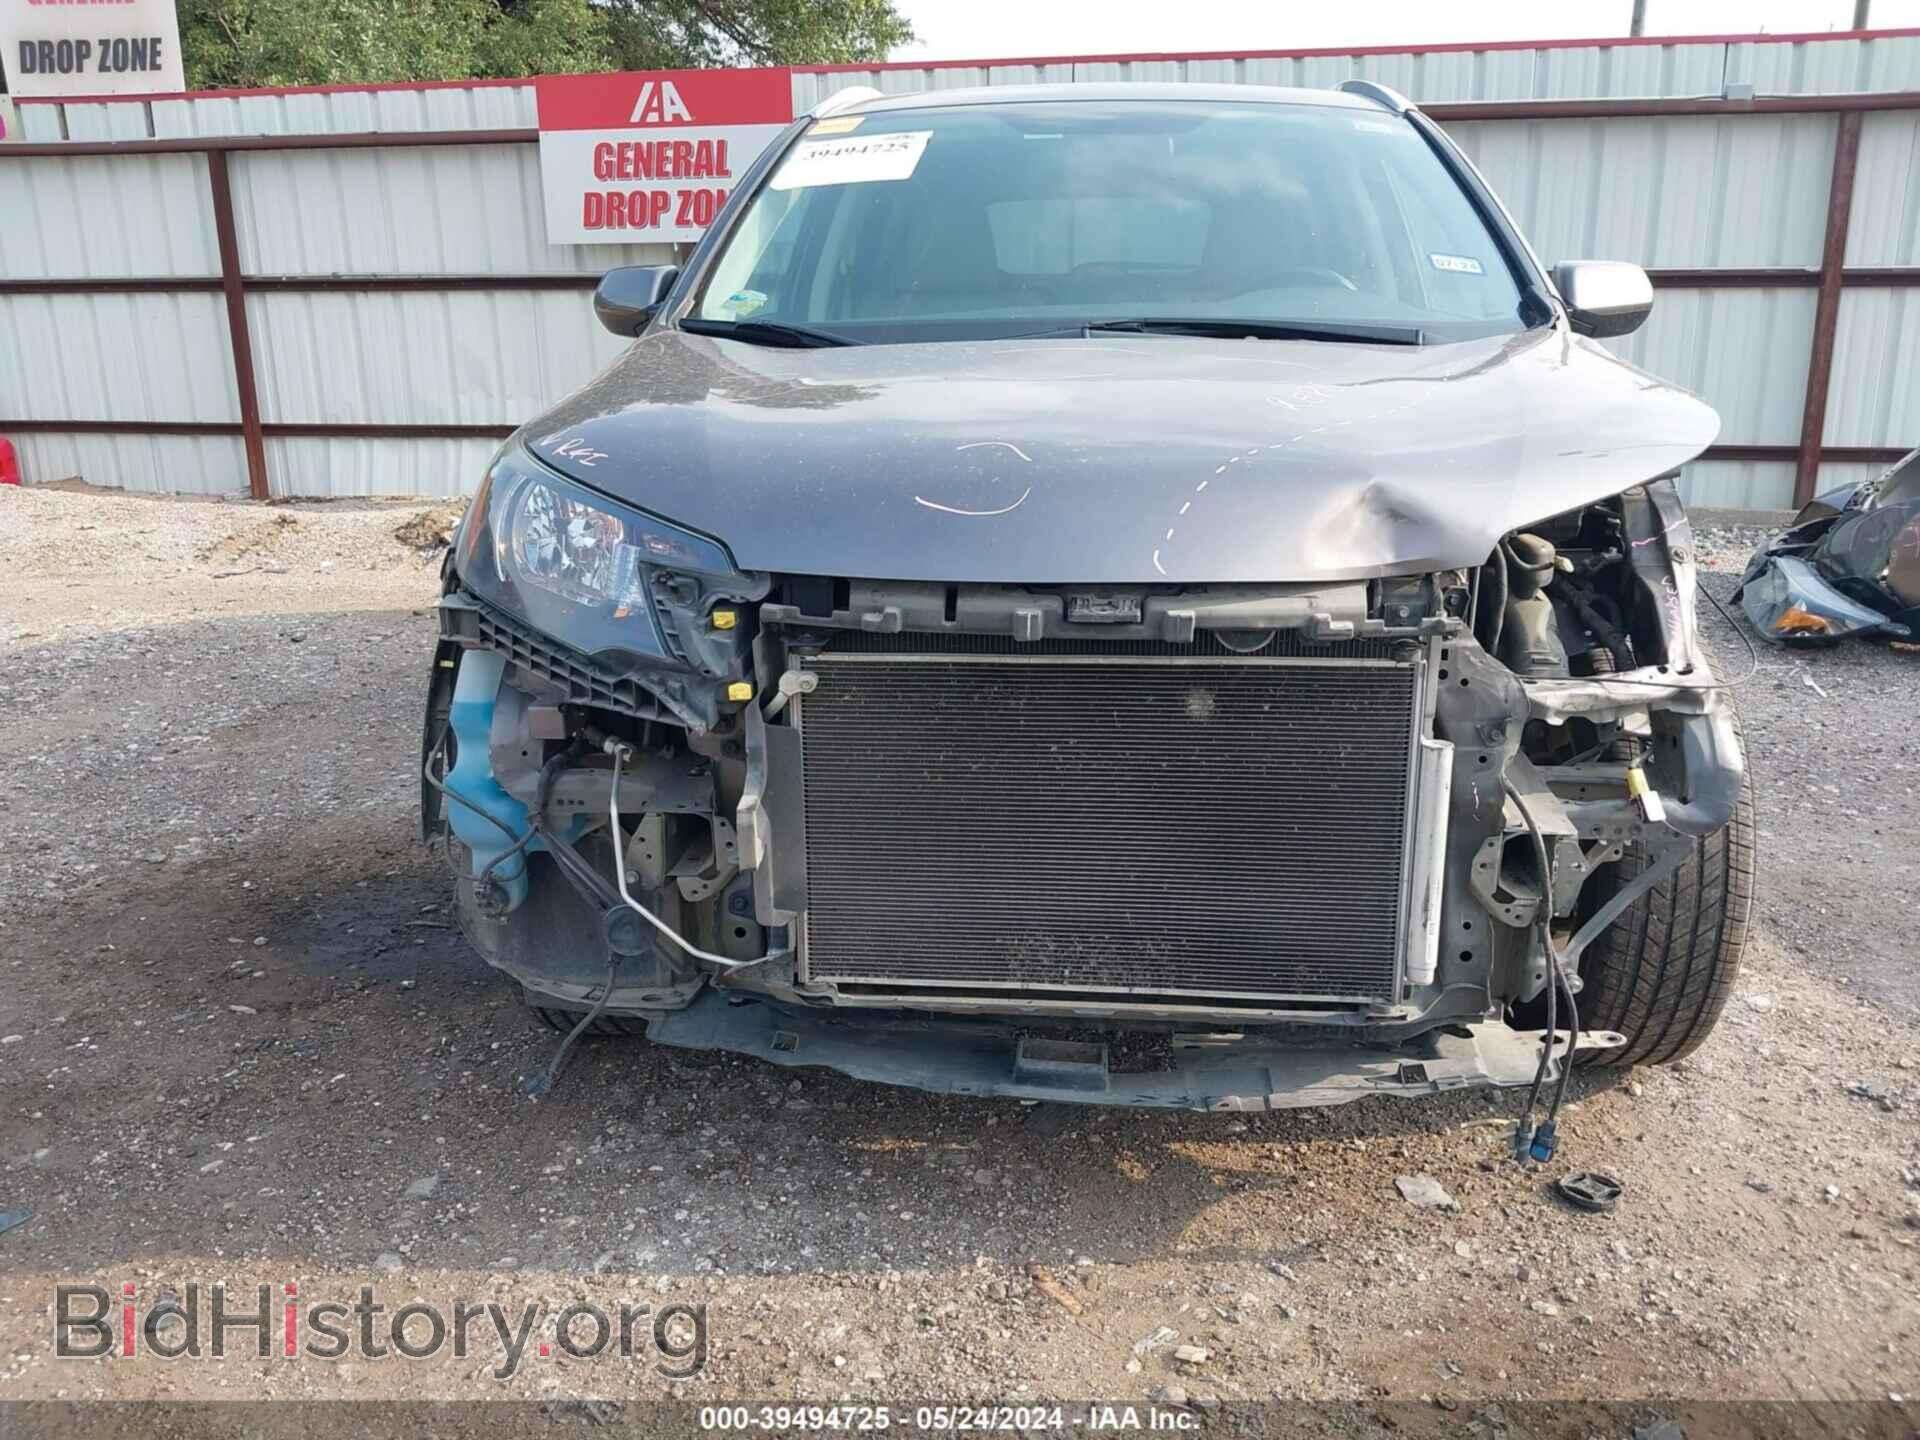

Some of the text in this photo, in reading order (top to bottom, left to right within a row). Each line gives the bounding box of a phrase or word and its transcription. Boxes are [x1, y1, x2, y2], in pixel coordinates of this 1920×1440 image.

[19, 37, 162, 74] DROP ZONE
[593, 139, 732, 181] GENERAL
[583, 190, 670, 230] DROP
